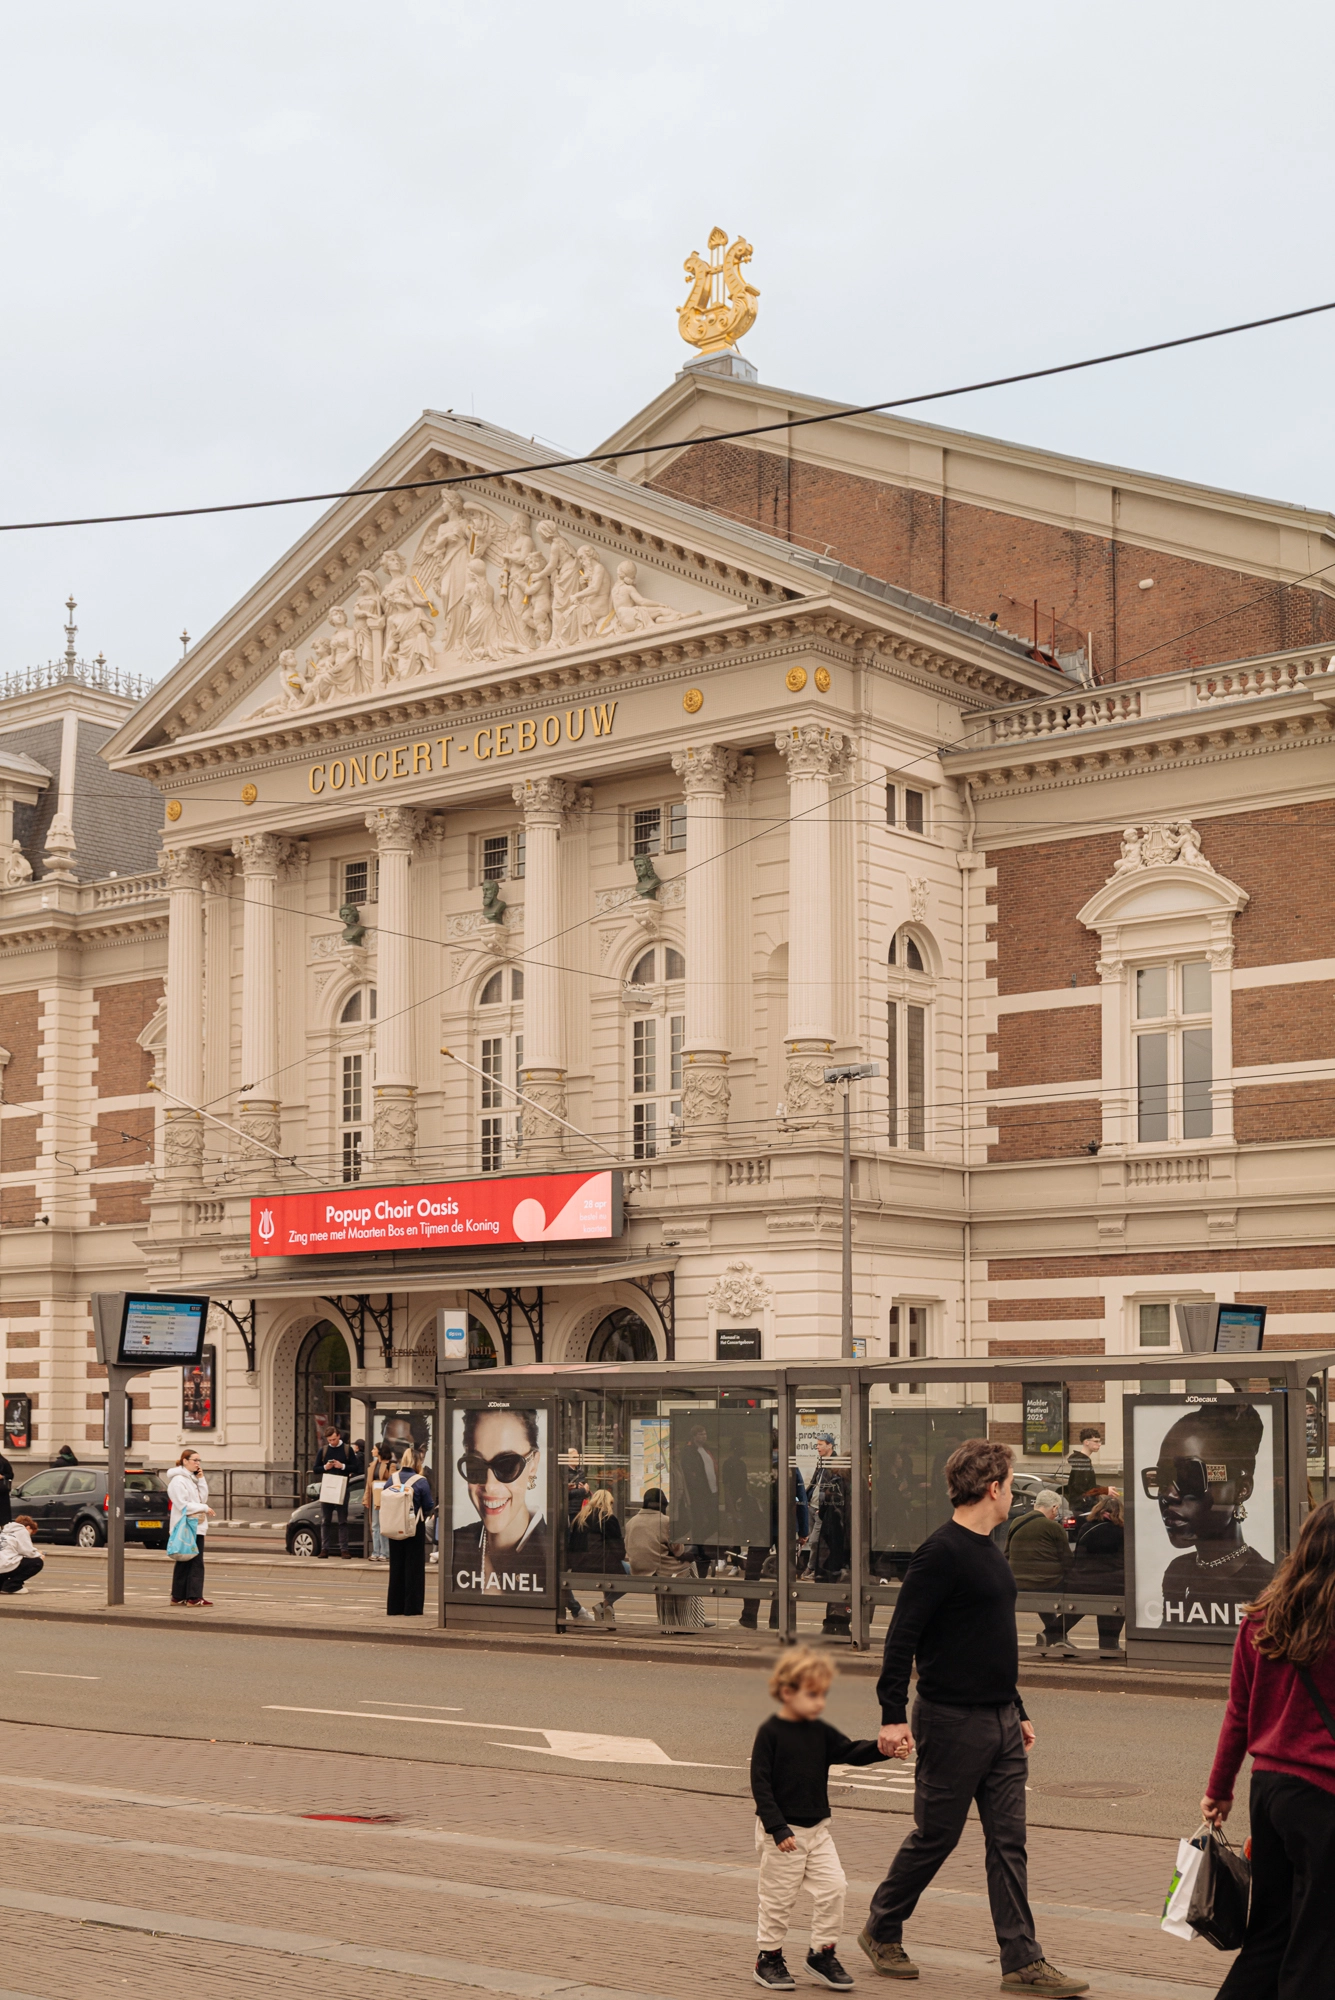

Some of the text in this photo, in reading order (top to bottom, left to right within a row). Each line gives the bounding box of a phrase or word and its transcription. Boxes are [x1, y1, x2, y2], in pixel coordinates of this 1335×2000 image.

[308, 701, 618, 794] CONCERT-GEBOUW
[326, 1196, 459, 1227] Popup Choir Oasis
[583, 1199, 607, 1210] 28 apr
[579, 1211, 597, 1221] bestel
[288, 1219, 499, 1246] Zing mee met Maarten Bos en Tijmen de Koning
[1026, 1406, 1049, 1414] Festival
[1185, 1395, 1217, 1403] JCDecaux
[456, 1570, 544, 1592] CHANEL
[1144, 1600, 1248, 1625] CHANE
